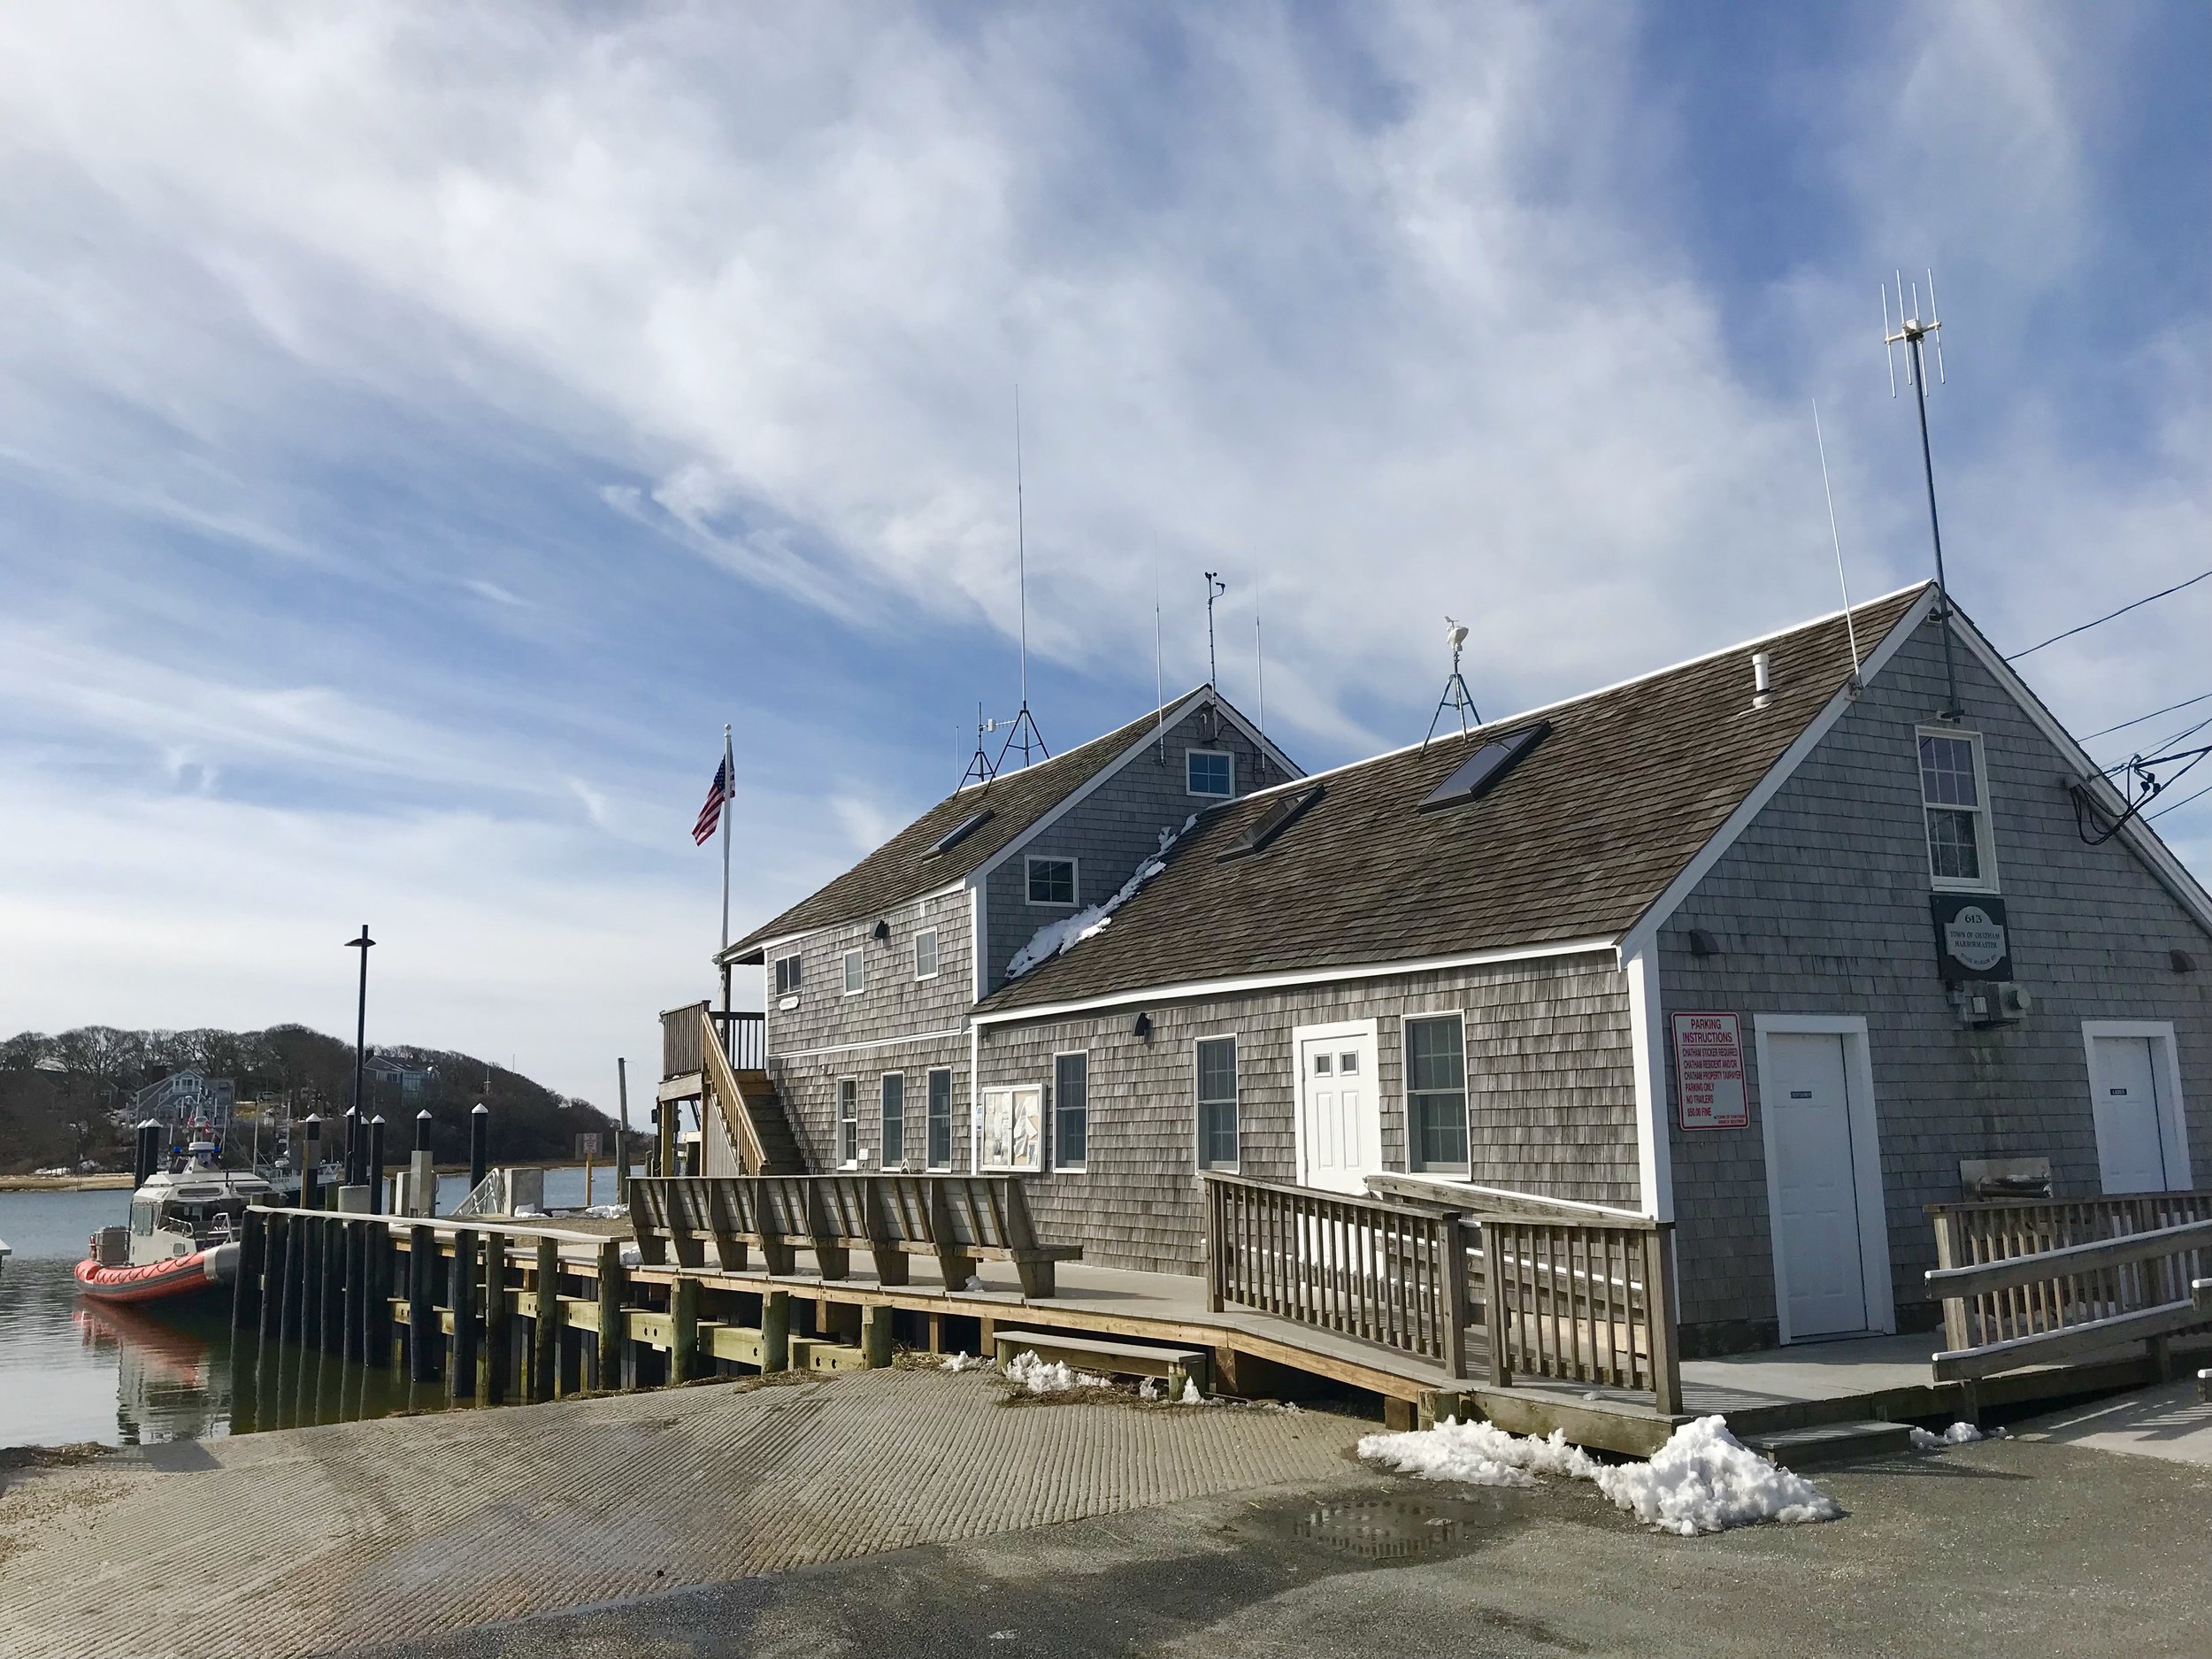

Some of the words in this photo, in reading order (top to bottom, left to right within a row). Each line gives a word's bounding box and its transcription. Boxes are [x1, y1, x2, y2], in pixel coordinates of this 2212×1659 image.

[1964, 915, 1982, 924] 613
[1691, 1018, 1721, 1029] PARKING
[1682, 1032, 1732, 1043] INSTRUCTIONS
[1683, 1048, 1701, 1057] CHATHAM
[1701, 1048, 1717, 1057] STICKER
[1718, 1048, 1738, 1056] REQUIRED
[1702, 1060, 1721, 1069] RESIDENT
[1685, 1071, 1702, 1080] CHATHAM
[1702, 1071, 1722, 1079] PROPERTY
[1685, 1083, 1703, 1092] PARKING
[1703, 1082, 1715, 1091] ONLY
[1686, 1095, 1693, 1104] NO
[1694, 1094, 1714, 1103] TRAILERS
[1701, 1107, 1712, 1116] FINE
